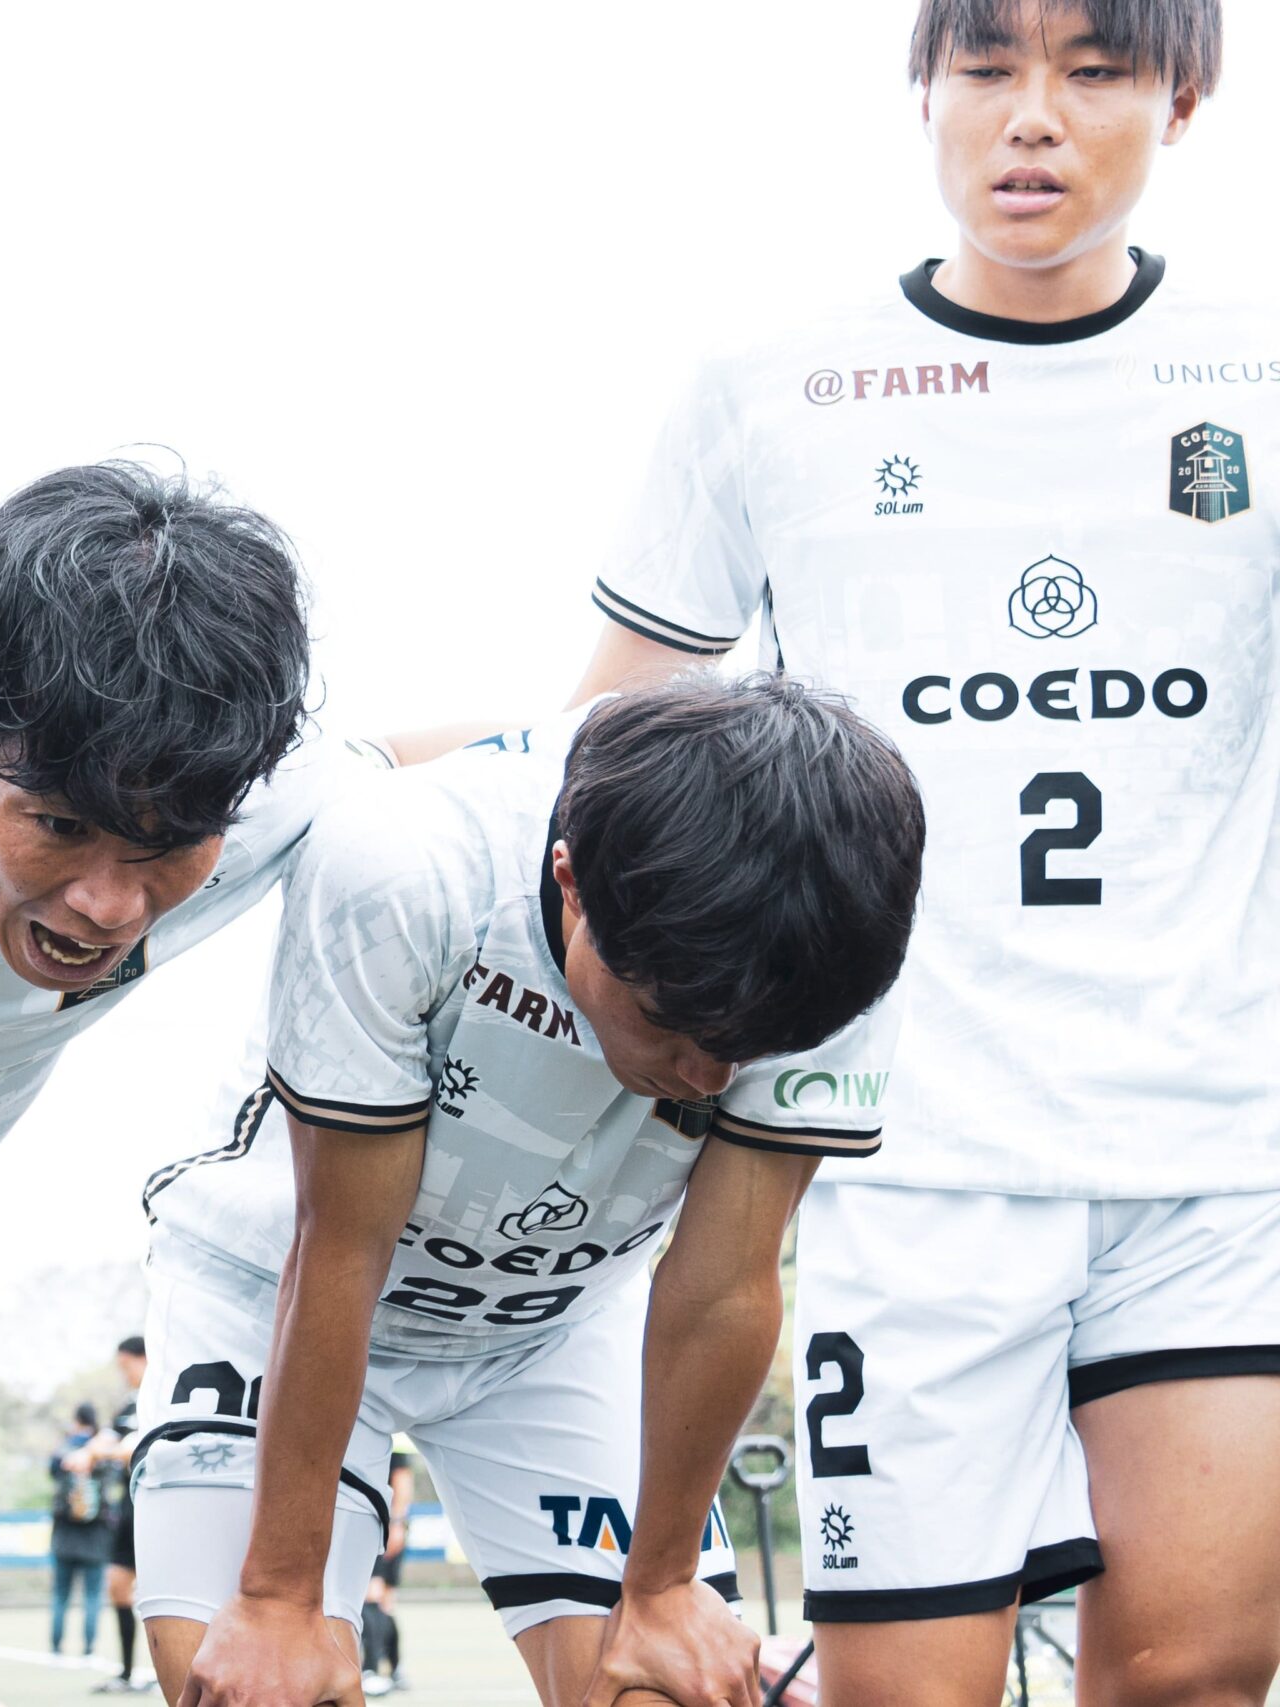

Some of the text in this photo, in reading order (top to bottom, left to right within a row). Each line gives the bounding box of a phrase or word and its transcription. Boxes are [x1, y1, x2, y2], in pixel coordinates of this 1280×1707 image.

[804, 361, 990, 406] @FARM
[1153, 362, 1280, 384] UNICUS
[1180, 430, 1234, 447] COEDO
[1226, 465, 1240, 475] 20
[874, 501, 924, 516] SOLum
[902, 667, 1208, 725] COEDO
[1019, 771, 1103, 906] 2
[379, 1276, 586, 1325] 29
[805, 1331, 873, 1479] 2
[822, 1555, 858, 1570] SOLum
